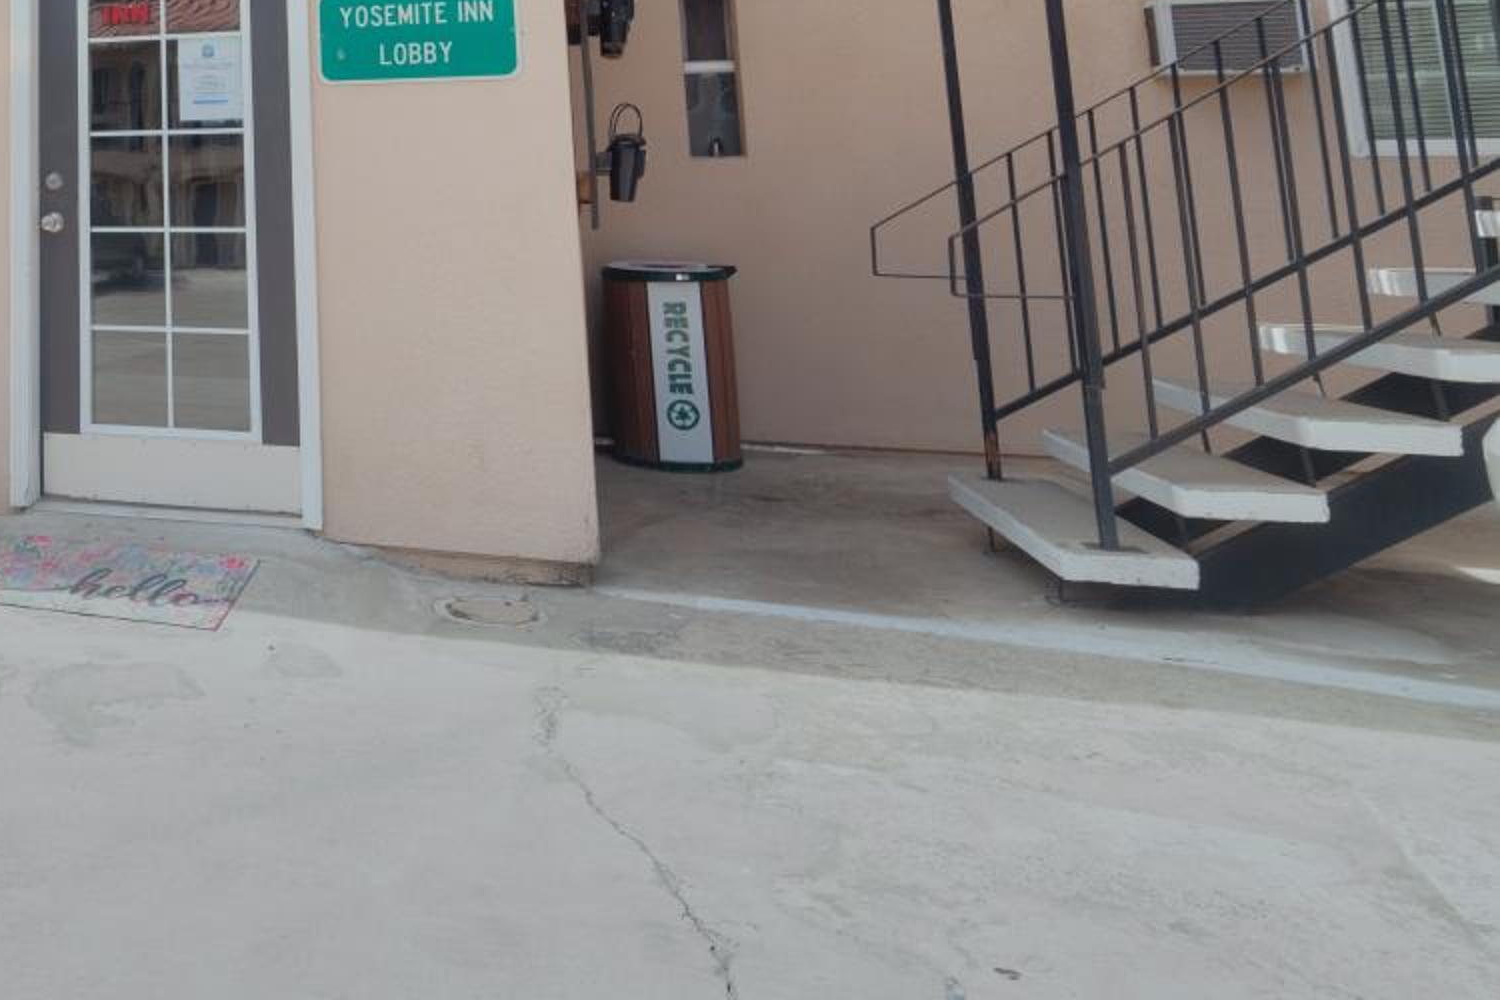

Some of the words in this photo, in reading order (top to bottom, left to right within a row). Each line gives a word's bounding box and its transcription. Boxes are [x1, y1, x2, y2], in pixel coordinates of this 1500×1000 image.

[339, 1, 448, 29] YOSEMITE
[379, 41, 453, 66] LOBBY
[662, 301, 694, 395] RECYCLE
[67, 566, 202, 608] hello
